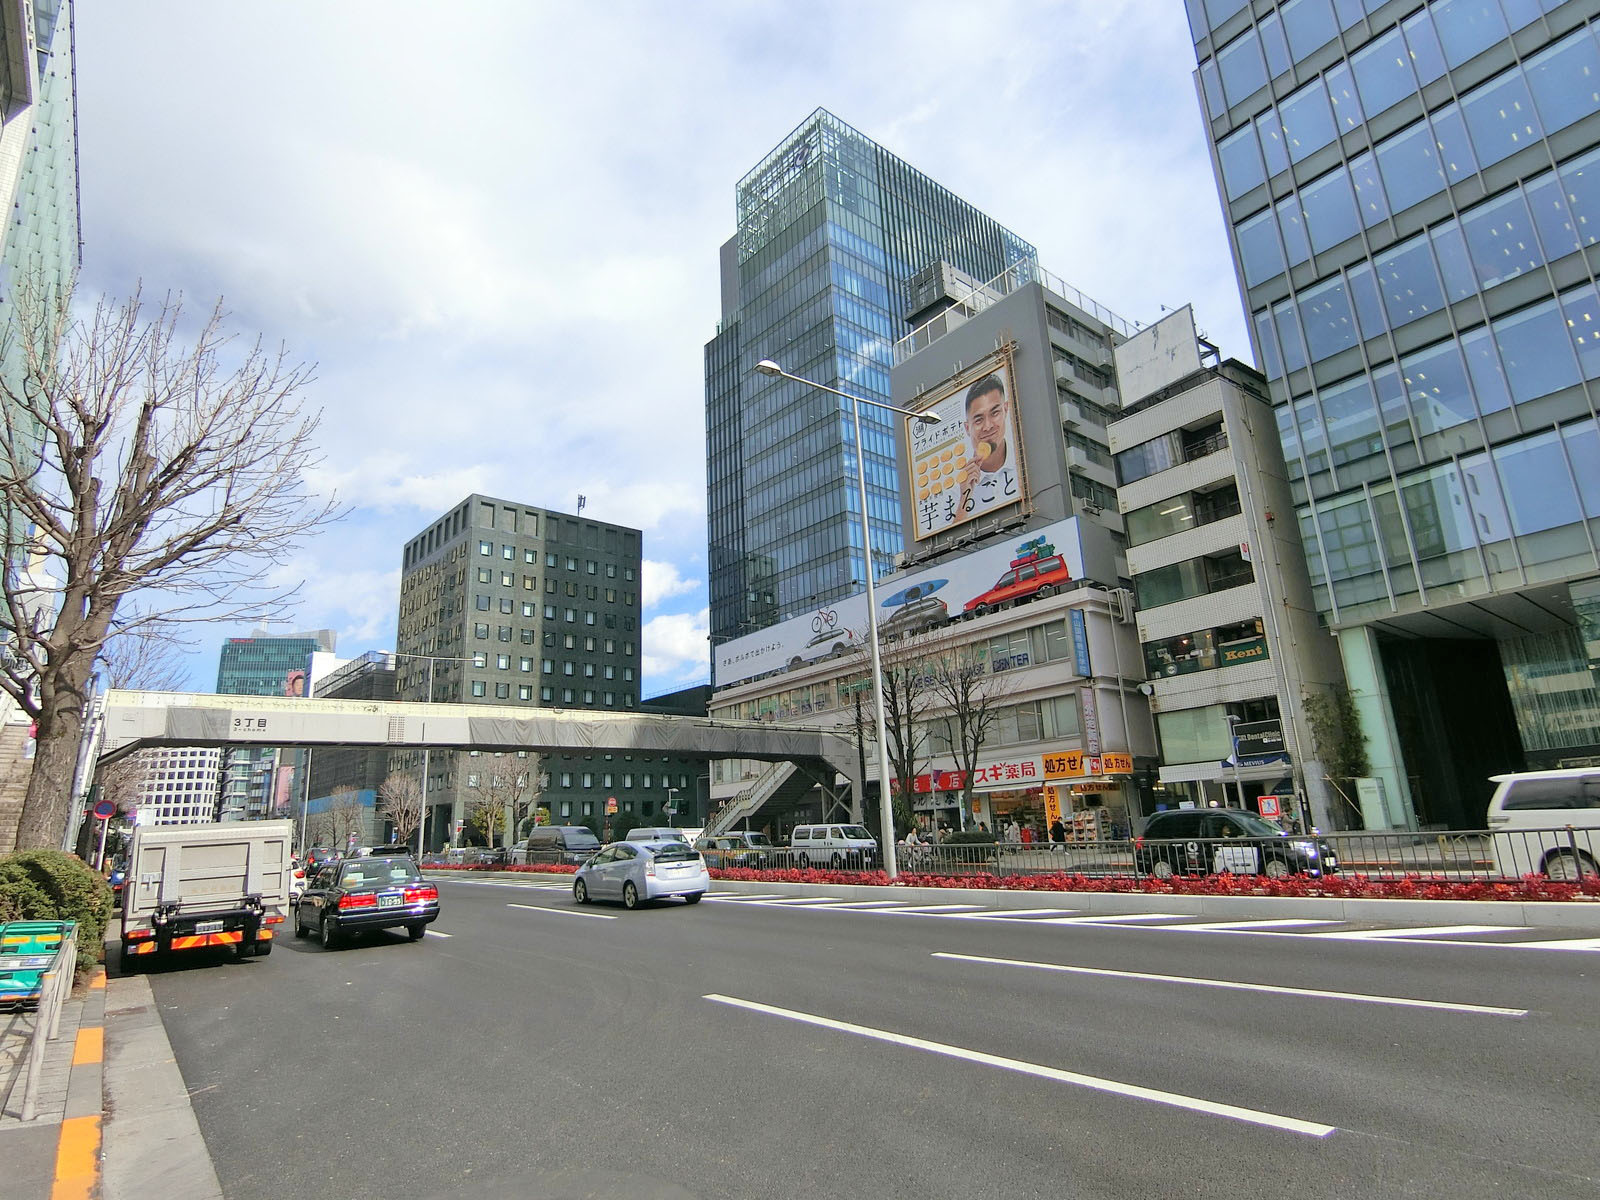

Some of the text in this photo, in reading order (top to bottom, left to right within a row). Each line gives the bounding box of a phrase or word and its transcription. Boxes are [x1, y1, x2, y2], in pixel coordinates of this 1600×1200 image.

[920, 471, 1016, 530] 芋まるごと
[1224, 645, 1263, 661] Kent
[234, 718, 267, 728] 3丁目
[1104, 757, 1131, 769] 処方せん
[975, 762, 1036, 783] スギ薬局
